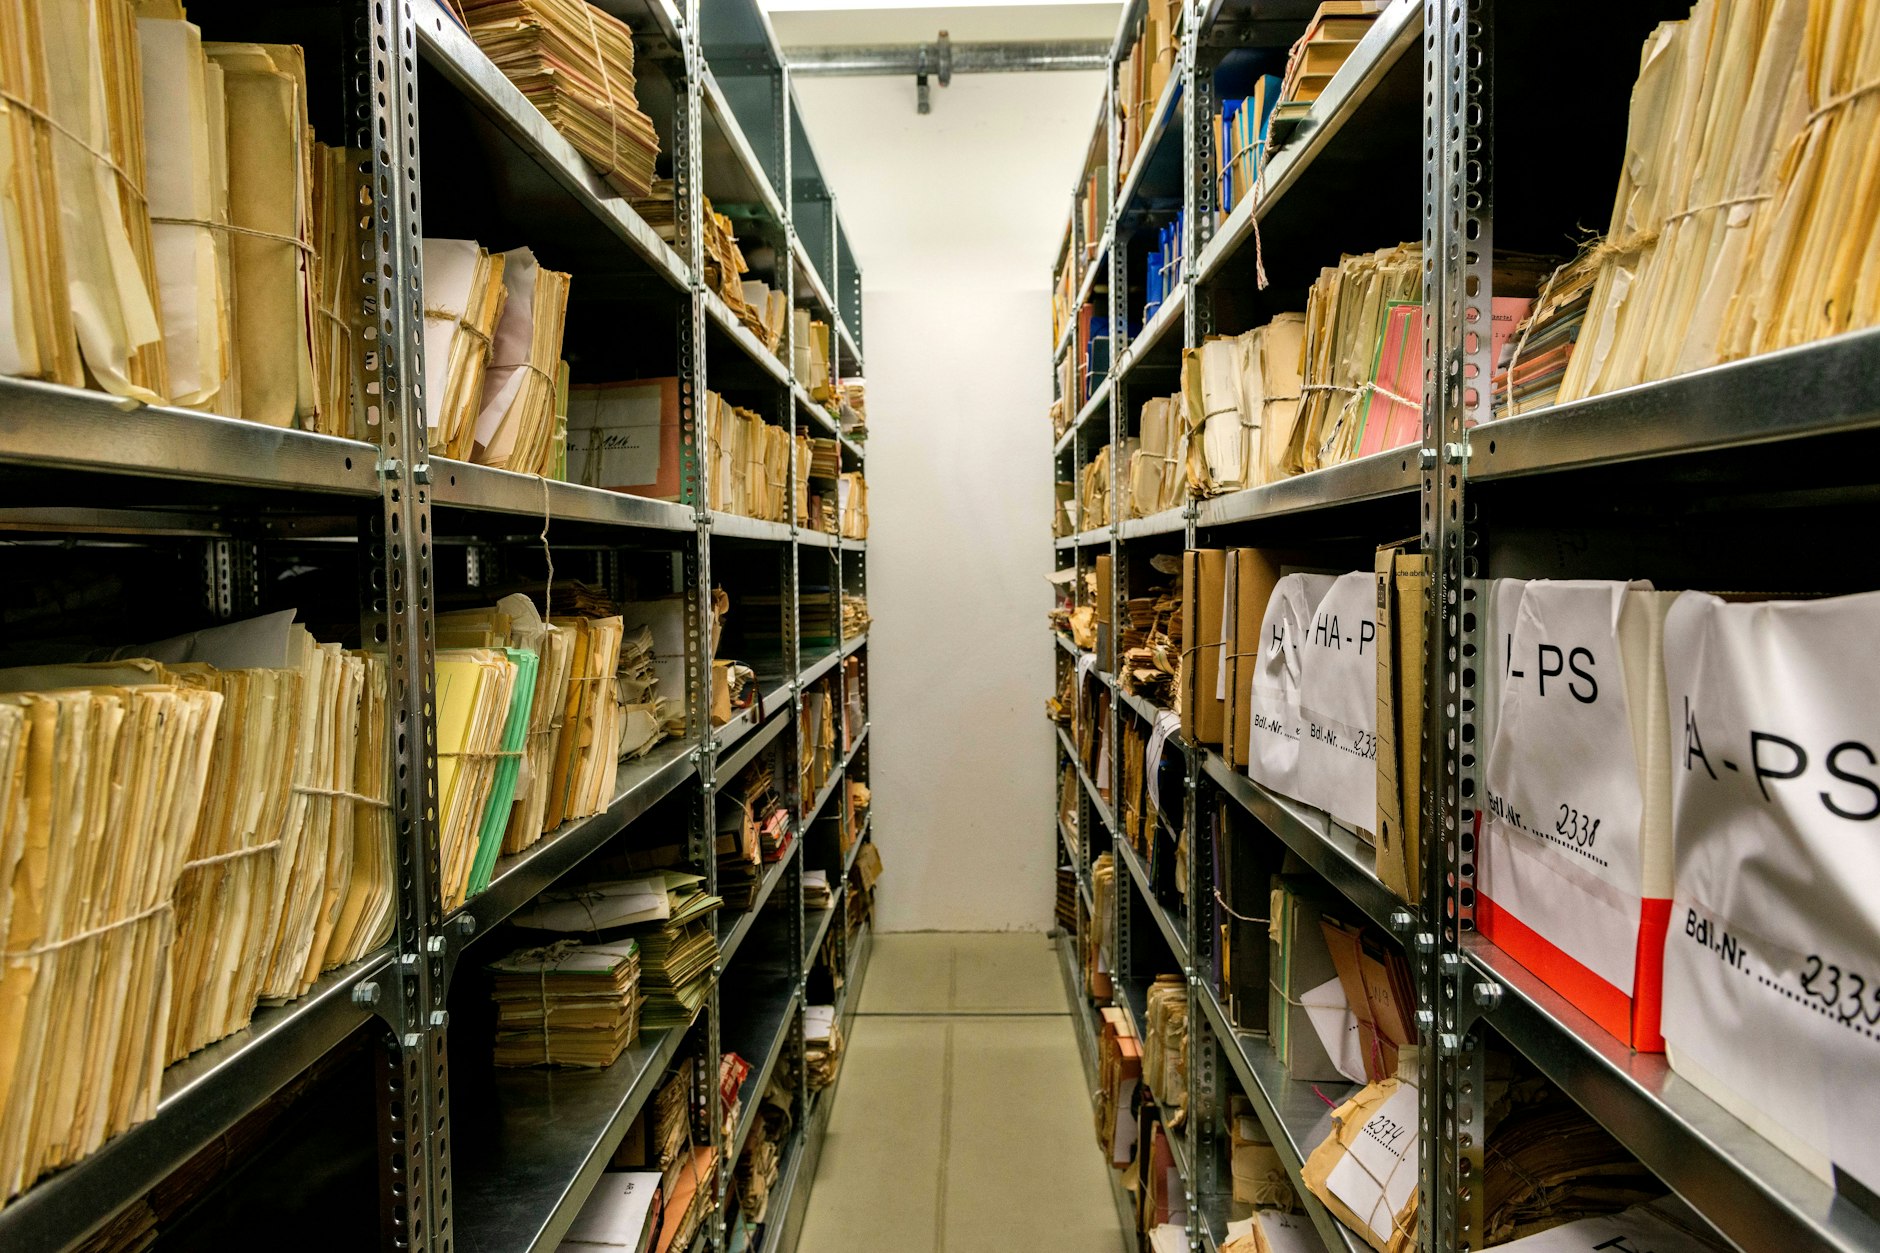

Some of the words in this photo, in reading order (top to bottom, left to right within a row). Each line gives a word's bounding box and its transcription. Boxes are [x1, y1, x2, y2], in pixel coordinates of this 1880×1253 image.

[1315, 612, 1341, 650] HA
[1539, 644, 1598, 704] PS
[1750, 730, 1880, 821] PS
[1556, 803, 1601, 848] 2338
[1367, 1115, 1405, 1147] 2374
